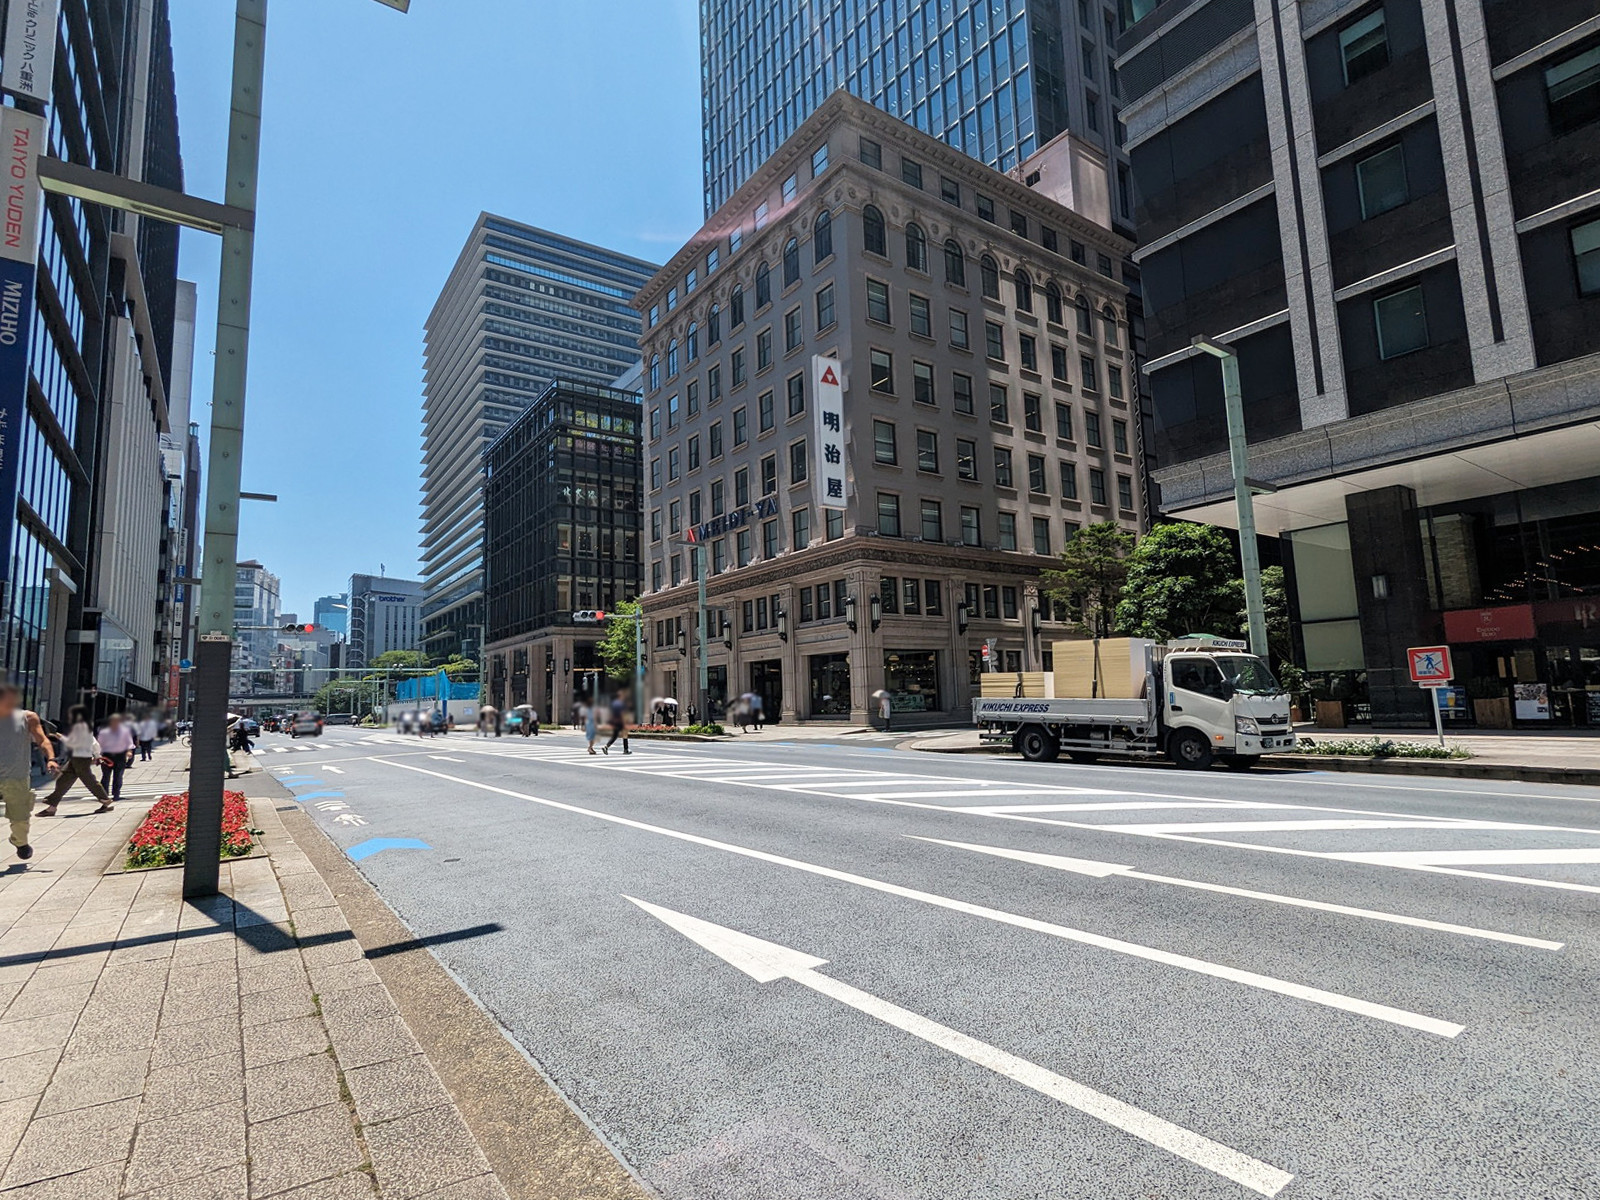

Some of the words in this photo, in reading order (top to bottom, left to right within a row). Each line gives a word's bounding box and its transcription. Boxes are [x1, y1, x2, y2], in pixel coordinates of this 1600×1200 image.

[10, 128, 29, 180] TAIYO
[5, 185, 24, 248] YUDEN
[0, 280, 22, 345] MIZUHO
[823, 411, 843, 498] 明治屋
[981, 703, 1013, 712] KIKUCHI
[1013, 704, 1050, 713] EXPRESS
